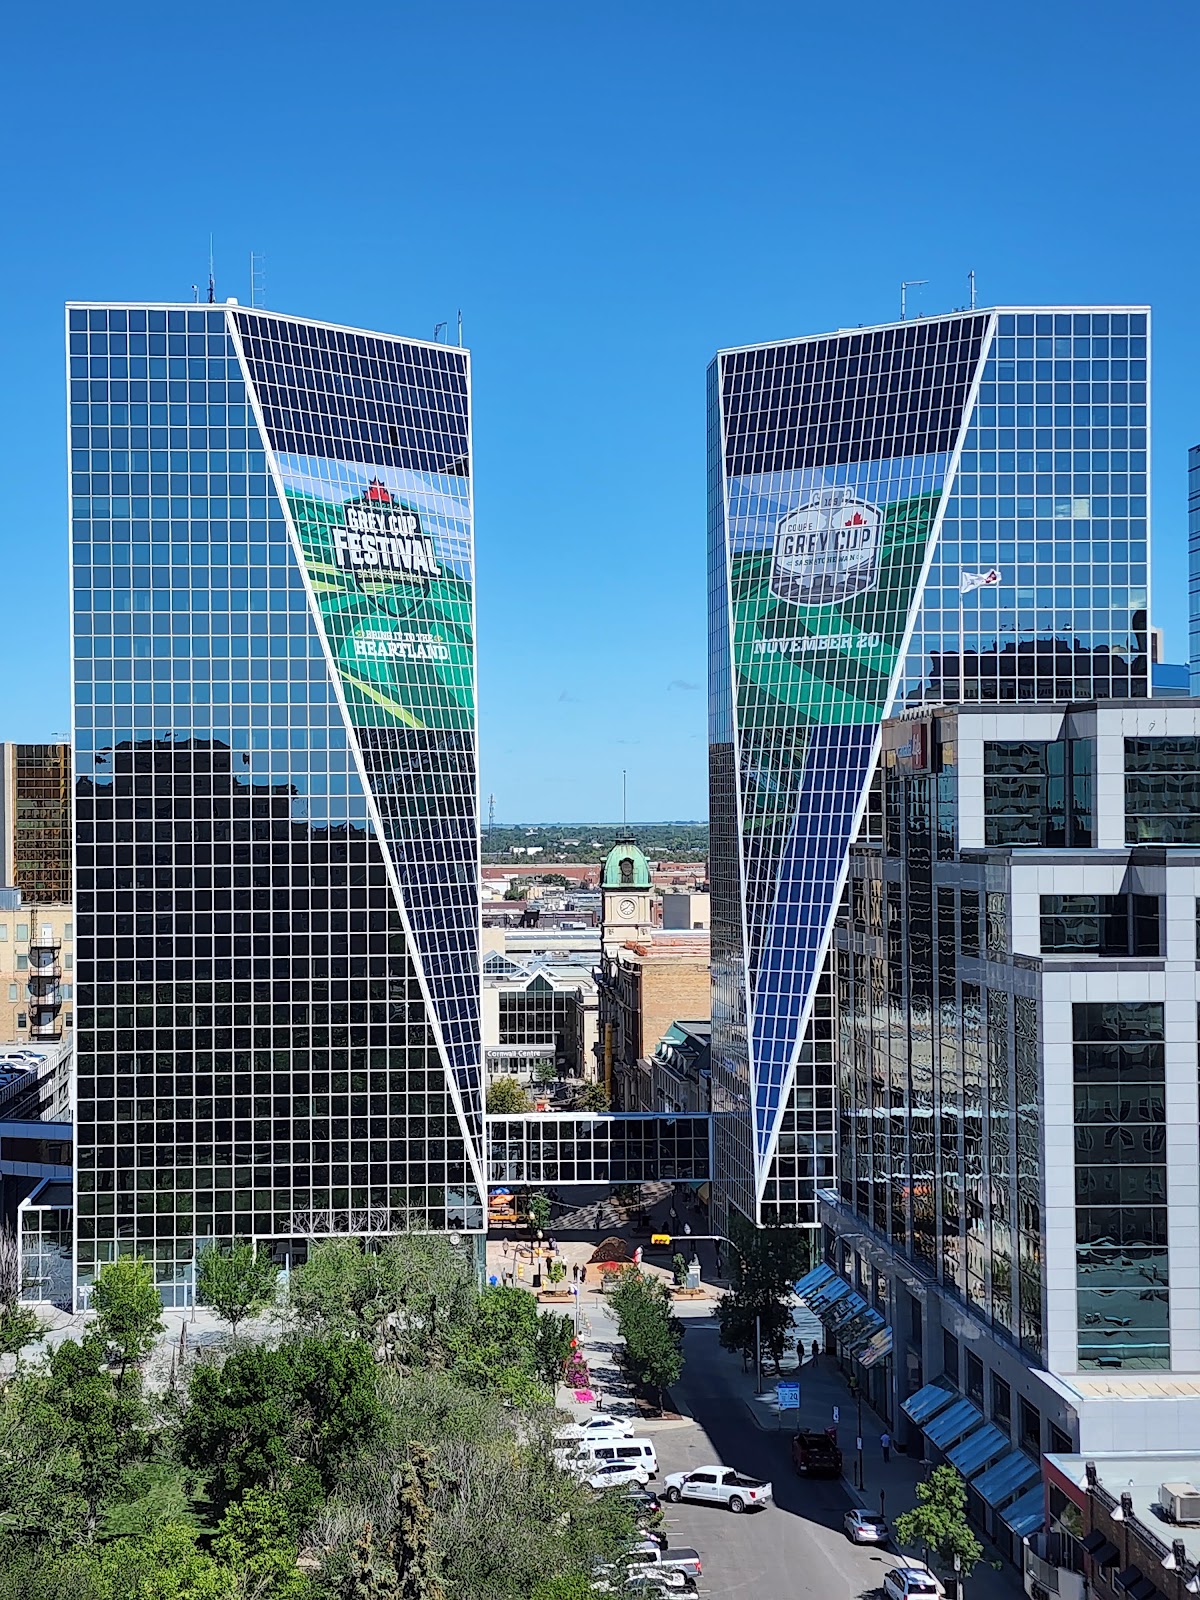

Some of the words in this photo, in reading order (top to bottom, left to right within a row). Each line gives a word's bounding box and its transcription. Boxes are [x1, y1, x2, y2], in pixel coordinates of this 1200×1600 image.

[347, 508, 386, 535] GREY
[387, 515, 418, 538] CUP
[787, 521, 813, 533] COUPE
[333, 528, 442, 576] FESTIVAL
[784, 532, 829, 558] GREY
[834, 528, 871, 553] CUP
[794, 554, 856, 567] SASKATCHEWAN
[358, 568, 426, 585] SASKATCHEWAN
[365, 629, 393, 640] BRING
[393, 631, 403, 641] IT
[404, 632, 416, 642] TO
[415, 633, 434, 643] THE
[753, 635, 853, 655] NOVEMBER
[856, 633, 880, 649] 20
